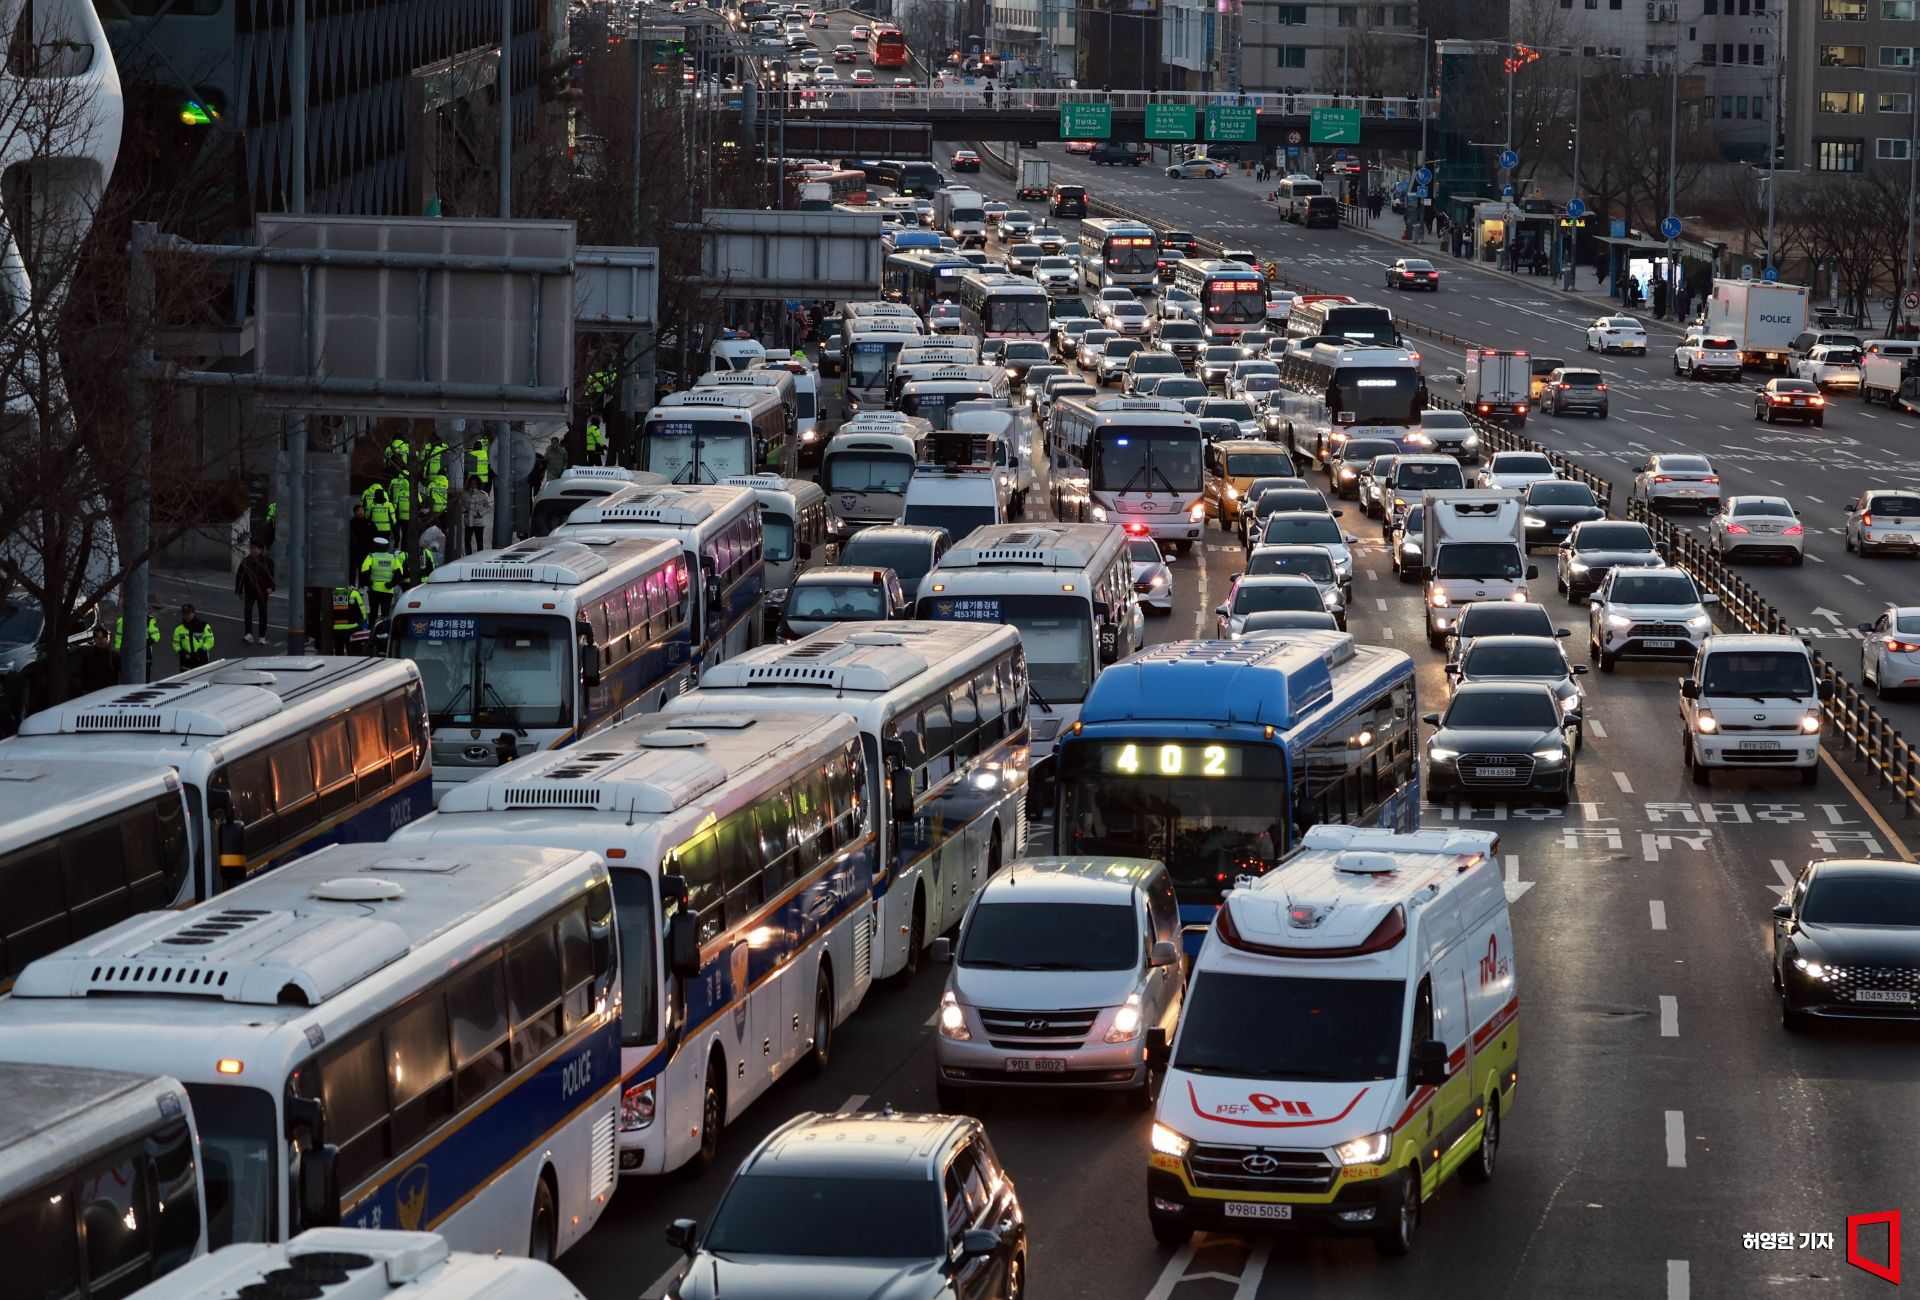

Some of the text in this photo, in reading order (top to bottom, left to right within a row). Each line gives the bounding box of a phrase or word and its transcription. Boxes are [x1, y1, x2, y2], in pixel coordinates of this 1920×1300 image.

[1760, 315, 1791, 324] POLICE
[955, 600, 999, 610] 서울기동경찰
[954, 610, 999, 619] 제53기동대-2
[429, 619, 475, 629] 서울기동경찰
[429, 629, 475, 639] 제53기동대-1
[1102, 633, 1115, 644] 53
[1117, 744, 1226, 775] 402
[391, 797, 411, 830] POLICE
[1644, 802, 1863, 824] 1호터널
[1884, 992, 1908, 1001] 3359
[1035, 1061, 1060, 1070] 8002
[562, 1049, 592, 1102] POLICE
[1259, 1206, 1291, 1222] 5055
